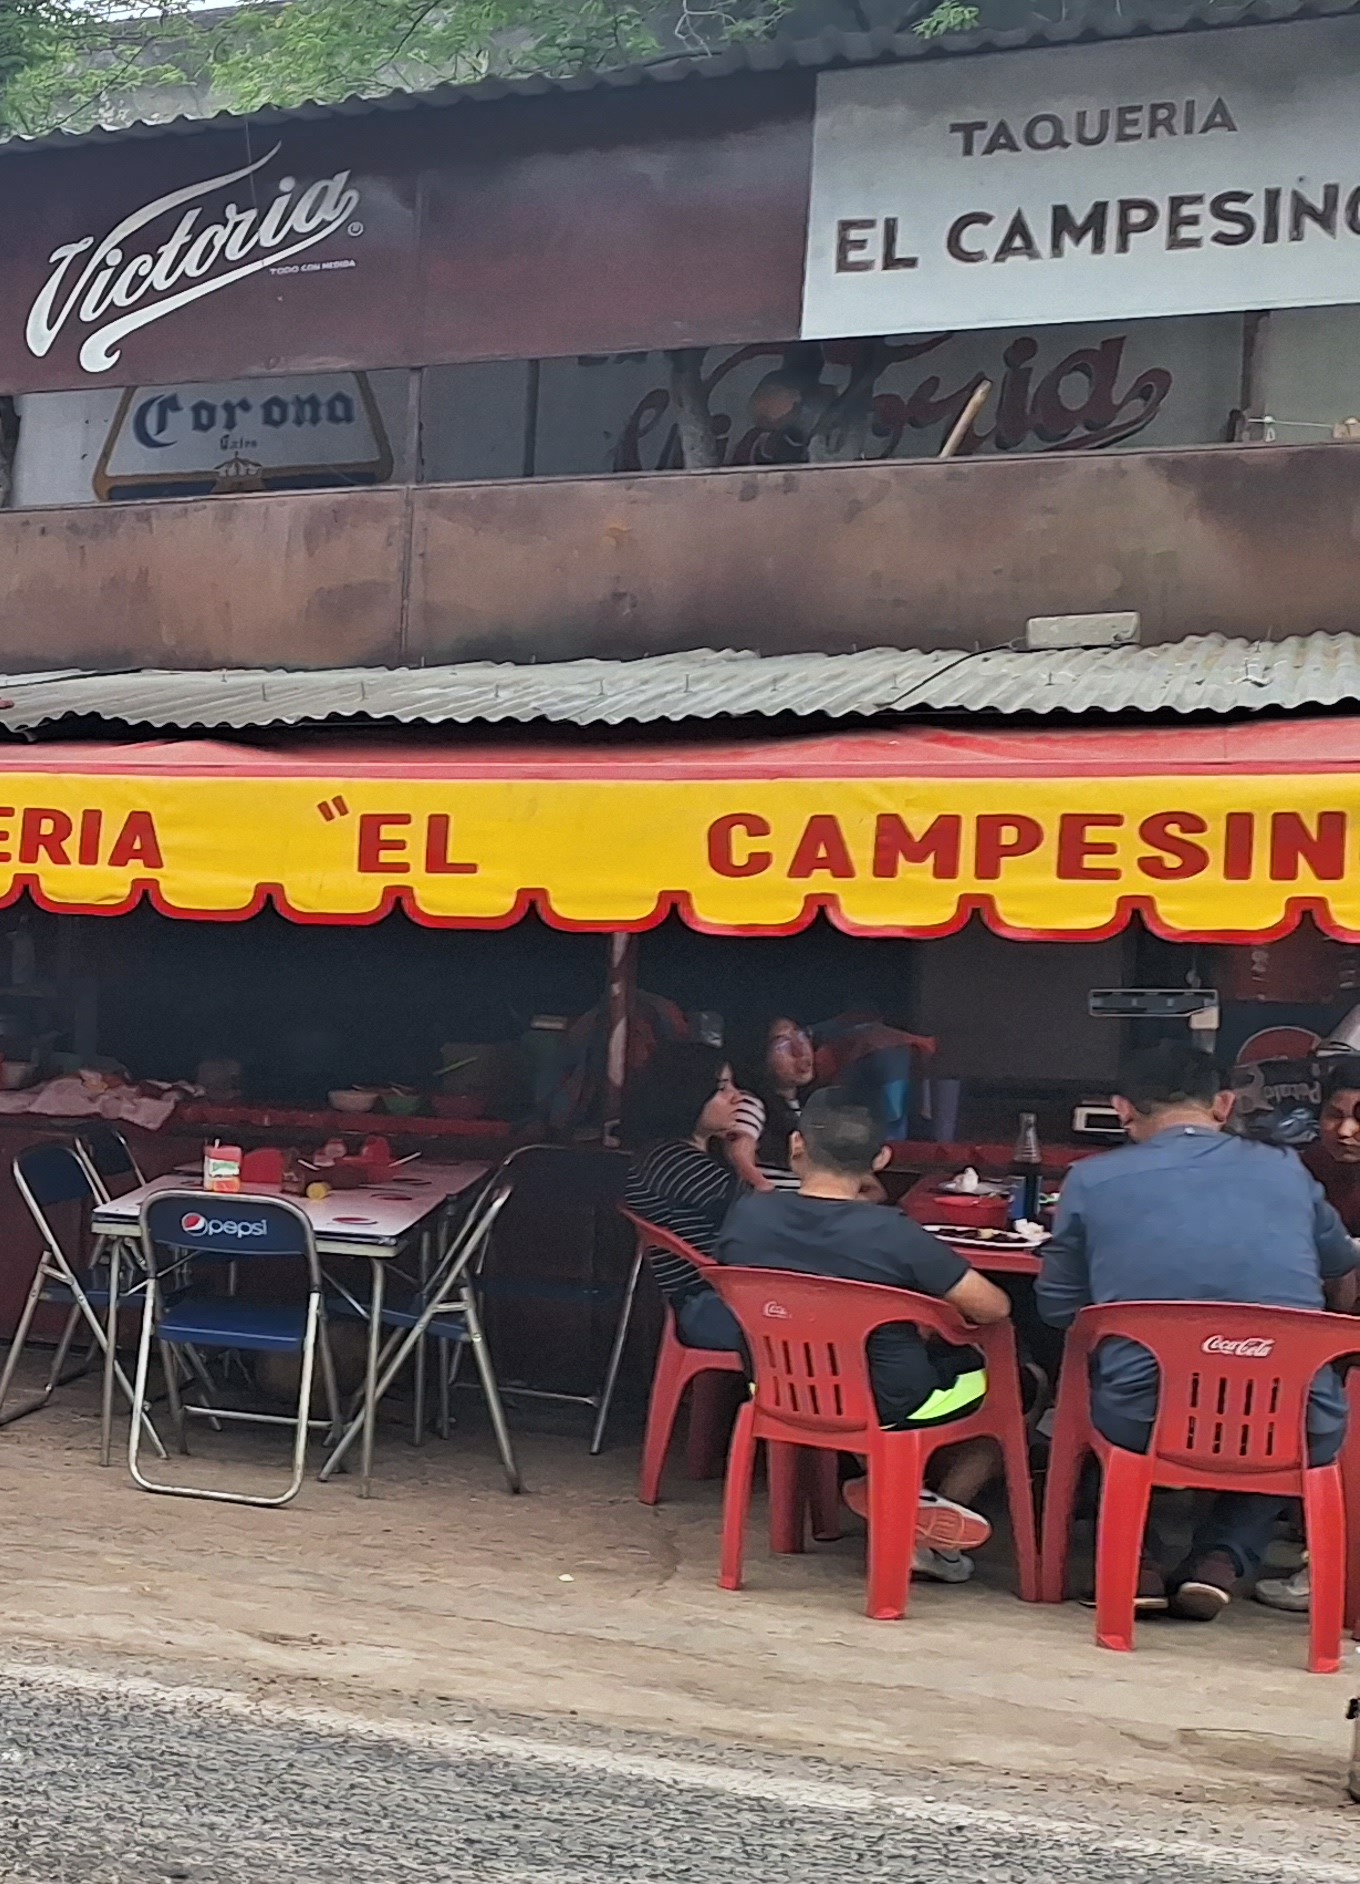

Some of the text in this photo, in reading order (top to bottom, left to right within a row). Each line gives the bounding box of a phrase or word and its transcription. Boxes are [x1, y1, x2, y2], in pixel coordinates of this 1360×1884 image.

[948, 96, 1239, 157] TAQUERIA
[25, 139, 361, 373] Victoria
[269, 265, 300, 275] TODO
[301, 263, 321, 271] CON
[834, 216, 920, 274] EL
[133, 390, 356, 449] Corona
[706, 811, 1360, 881] CAMPESIN
[208, 1219, 268, 1239] pepsi
